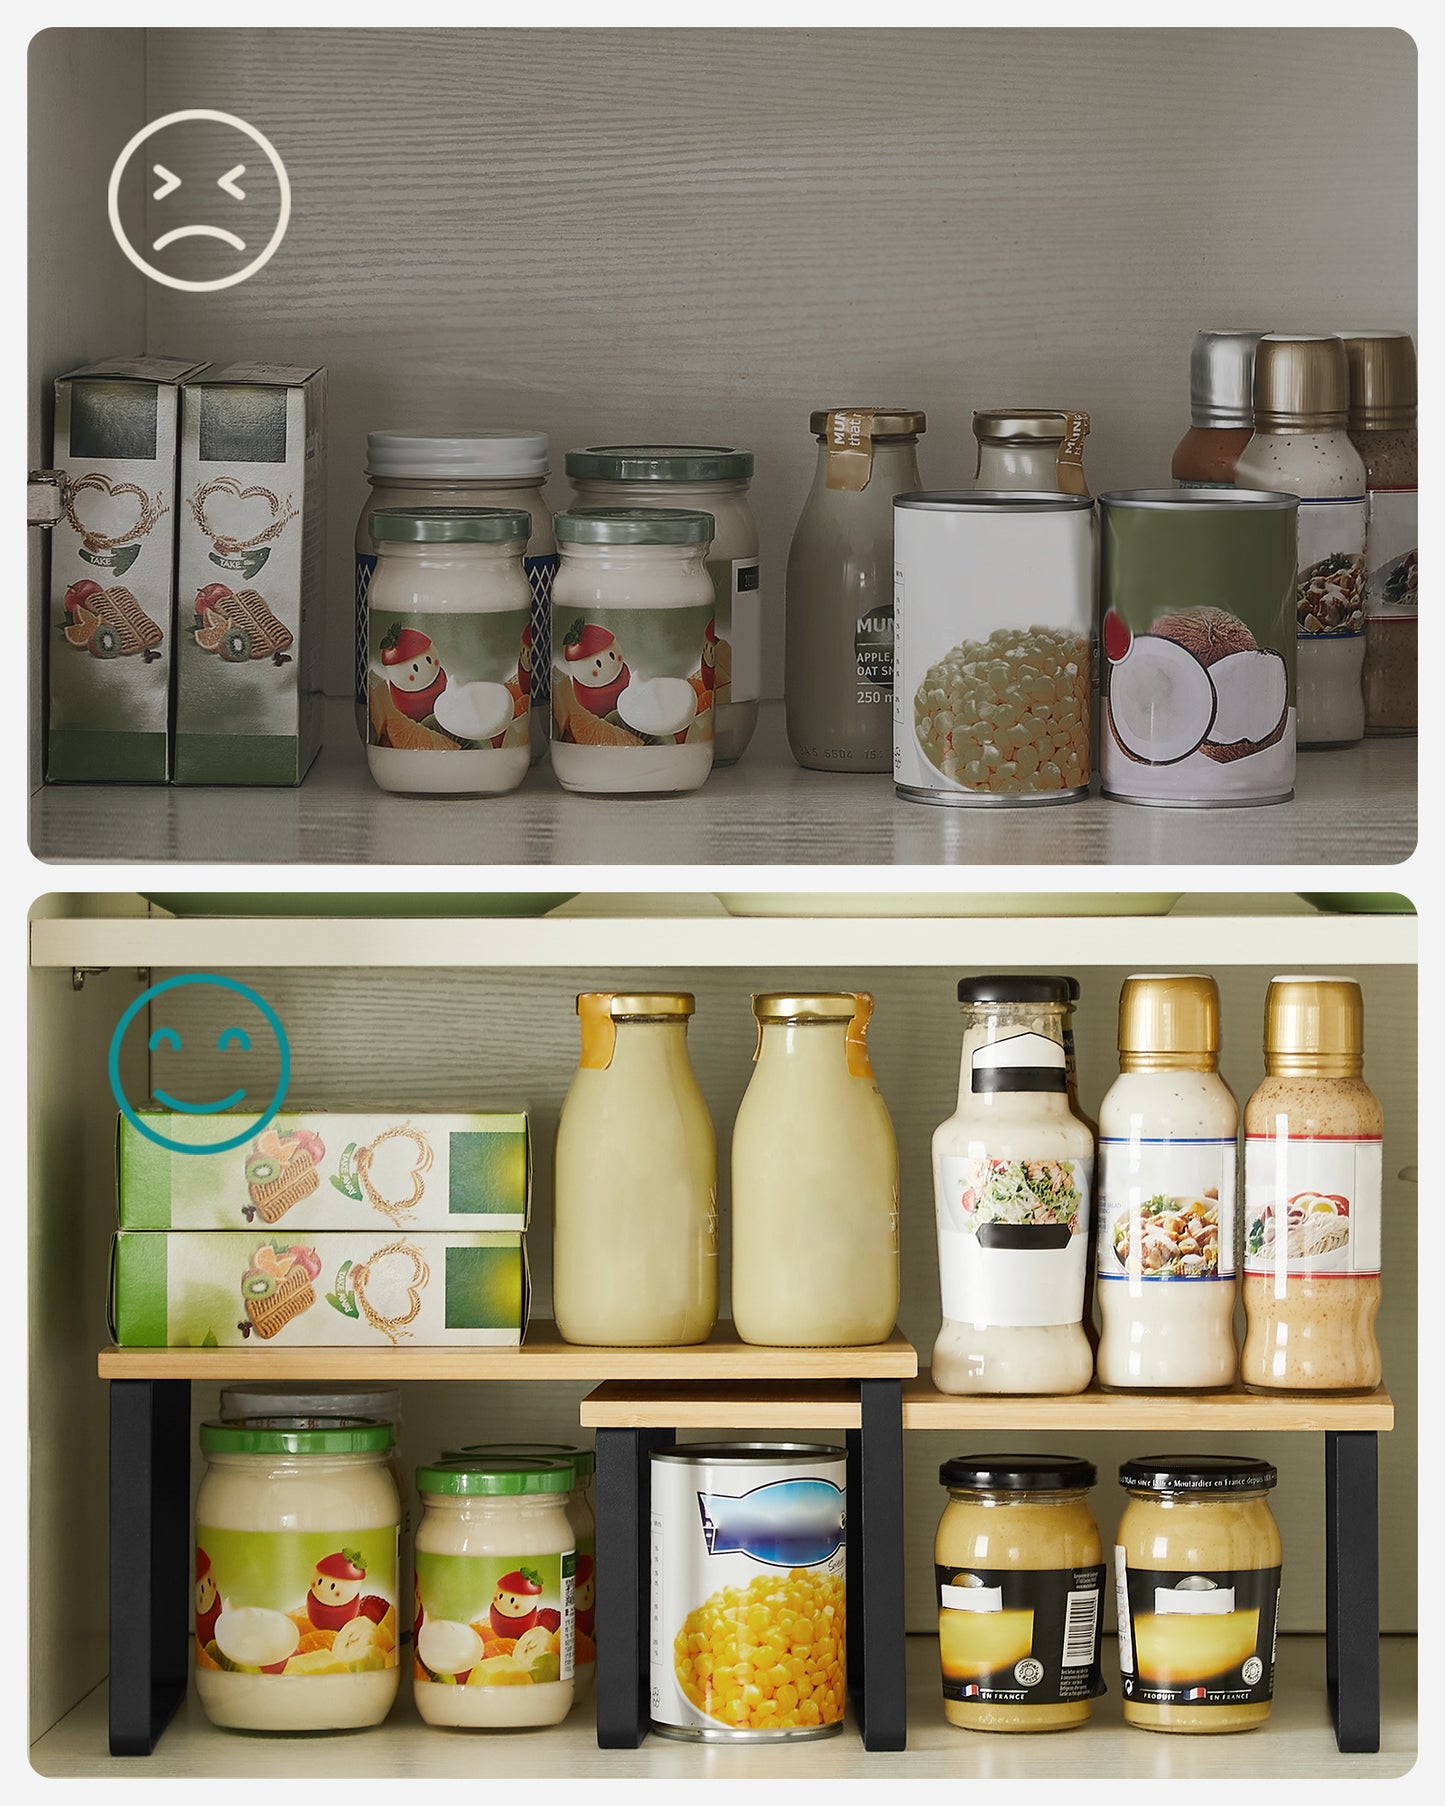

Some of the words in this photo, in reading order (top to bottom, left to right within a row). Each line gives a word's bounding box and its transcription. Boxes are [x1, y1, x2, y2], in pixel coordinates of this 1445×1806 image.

[848, 419, 861, 446] that
[89, 555, 112, 566] TAKE
[219, 558, 242, 569] TAKE
[857, 666, 878, 676] OAT
[857, 691, 880, 703] 250
[1173, 1479, 1212, 1488] Moutardier
[1214, 1479, 1223, 1487] en
[1224, 1478, 1245, 1487] France
[981, 1692, 992, 1700] EN
[1143, 1692, 1176, 1701] PRODUIT
[1222, 1693, 1249, 1701] FRANCE
